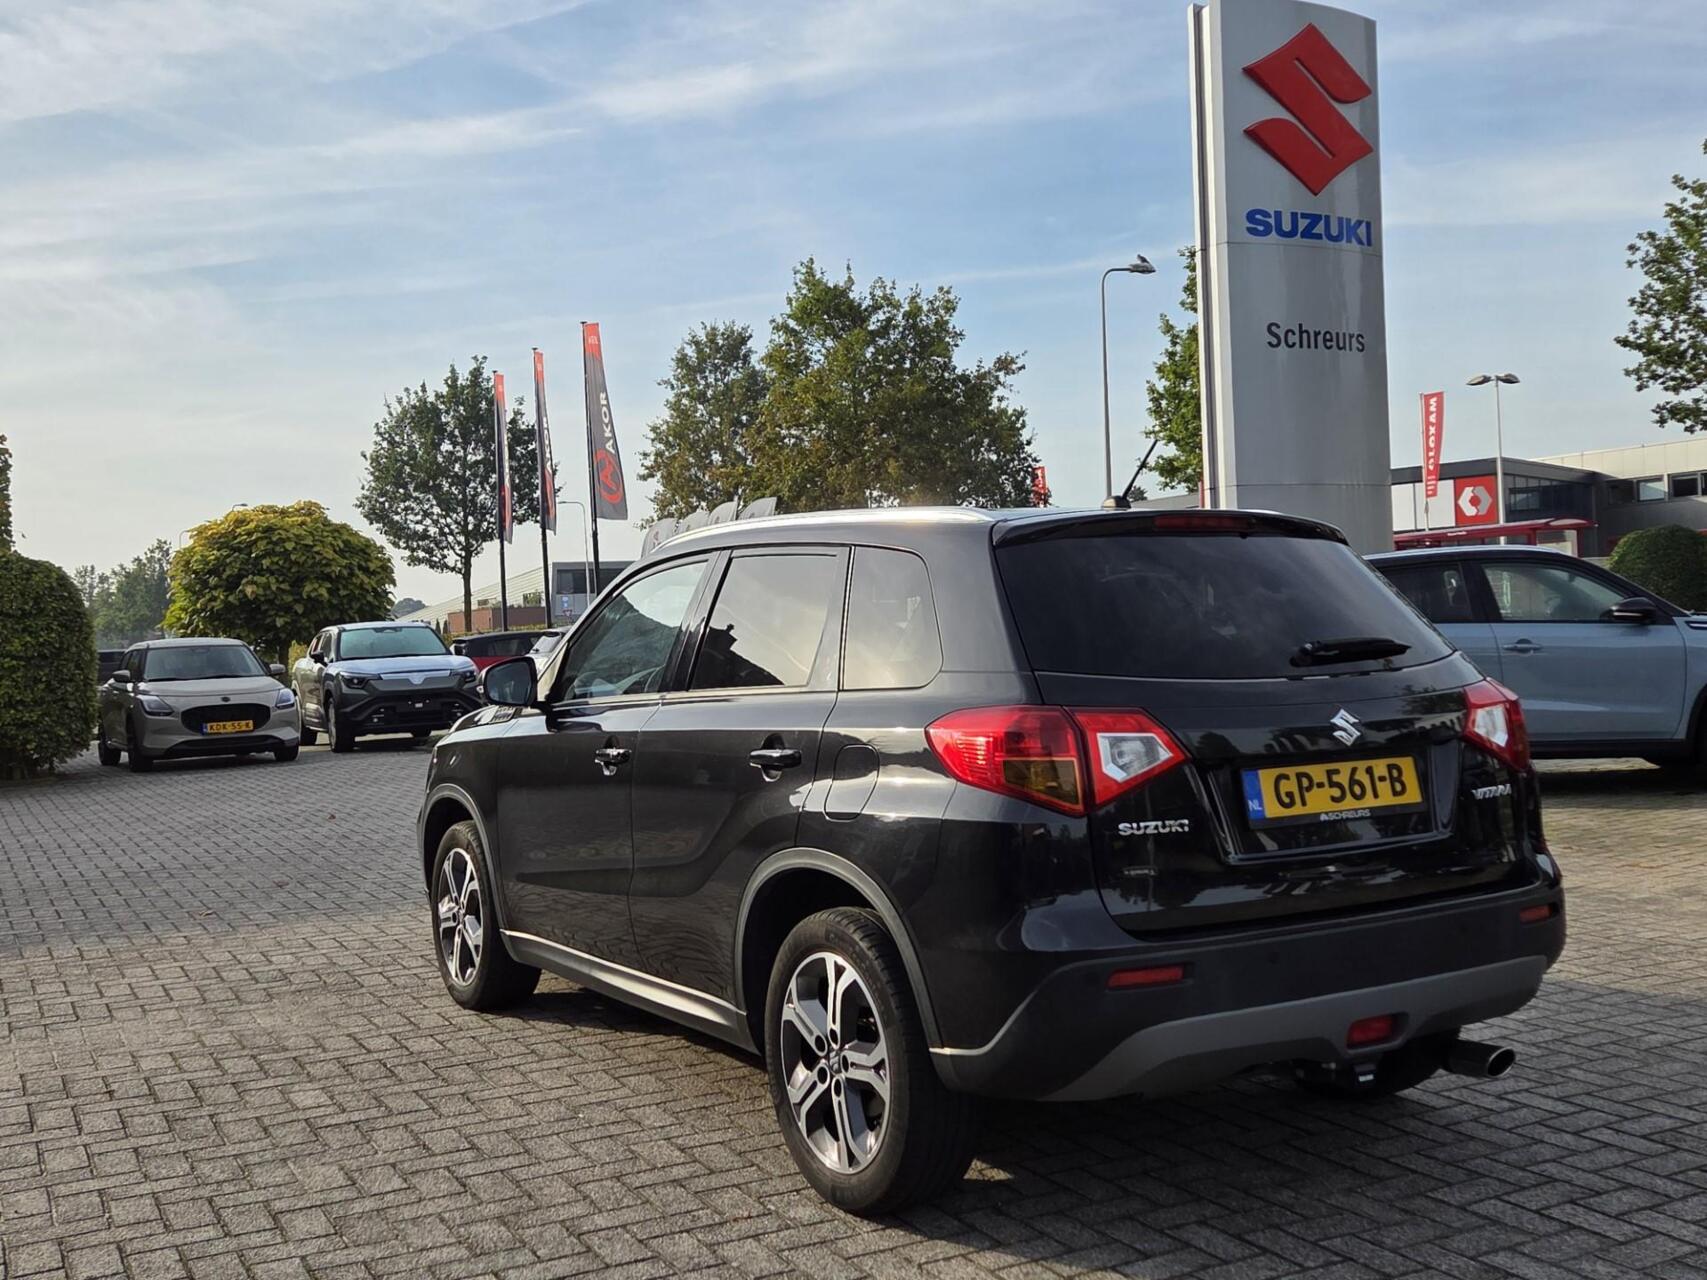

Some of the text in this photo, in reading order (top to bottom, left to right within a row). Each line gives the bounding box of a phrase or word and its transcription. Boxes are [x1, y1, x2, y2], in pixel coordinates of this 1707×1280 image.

[1245, 208, 1372, 247] SUZUKI
[1266, 322, 1365, 353] Schreurs
[600, 391, 616, 455] AKOR
[1273, 763, 1407, 809] GP-561-B
[1248, 800, 1263, 811] NL
[1118, 819, 1189, 836] SUZUKI
